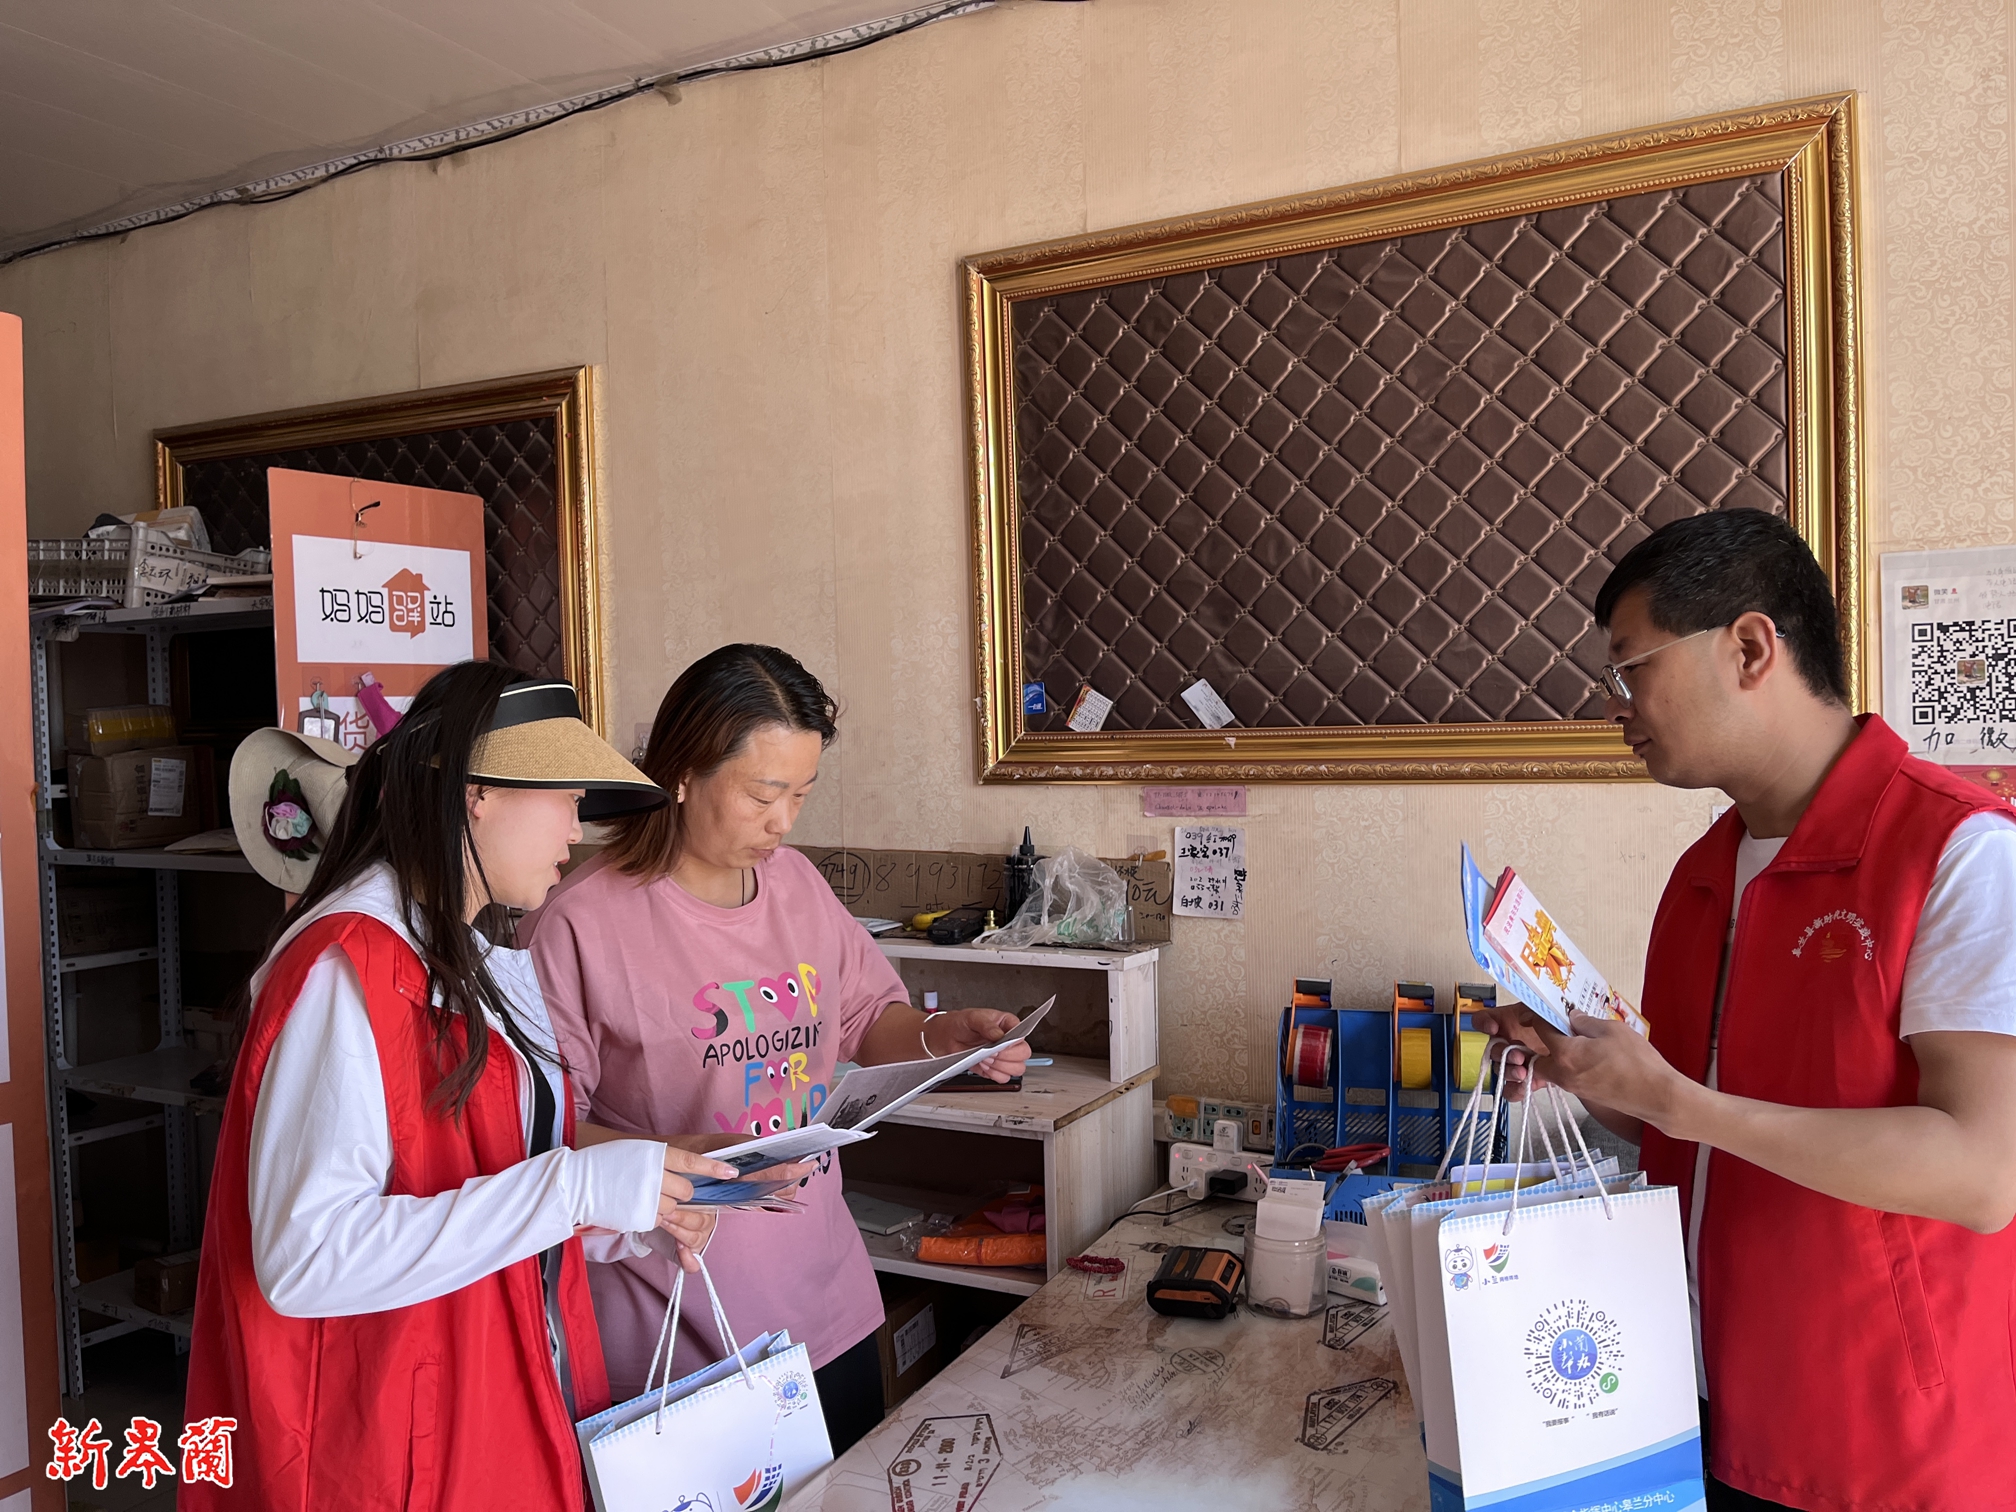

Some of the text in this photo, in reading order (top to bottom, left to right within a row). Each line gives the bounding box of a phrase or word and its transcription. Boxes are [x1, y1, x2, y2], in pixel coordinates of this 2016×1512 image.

[319, 587, 455, 628] 妈妈驿站
[1212, 847, 1230, 858] 037
[1208, 900, 1225, 911] 031
